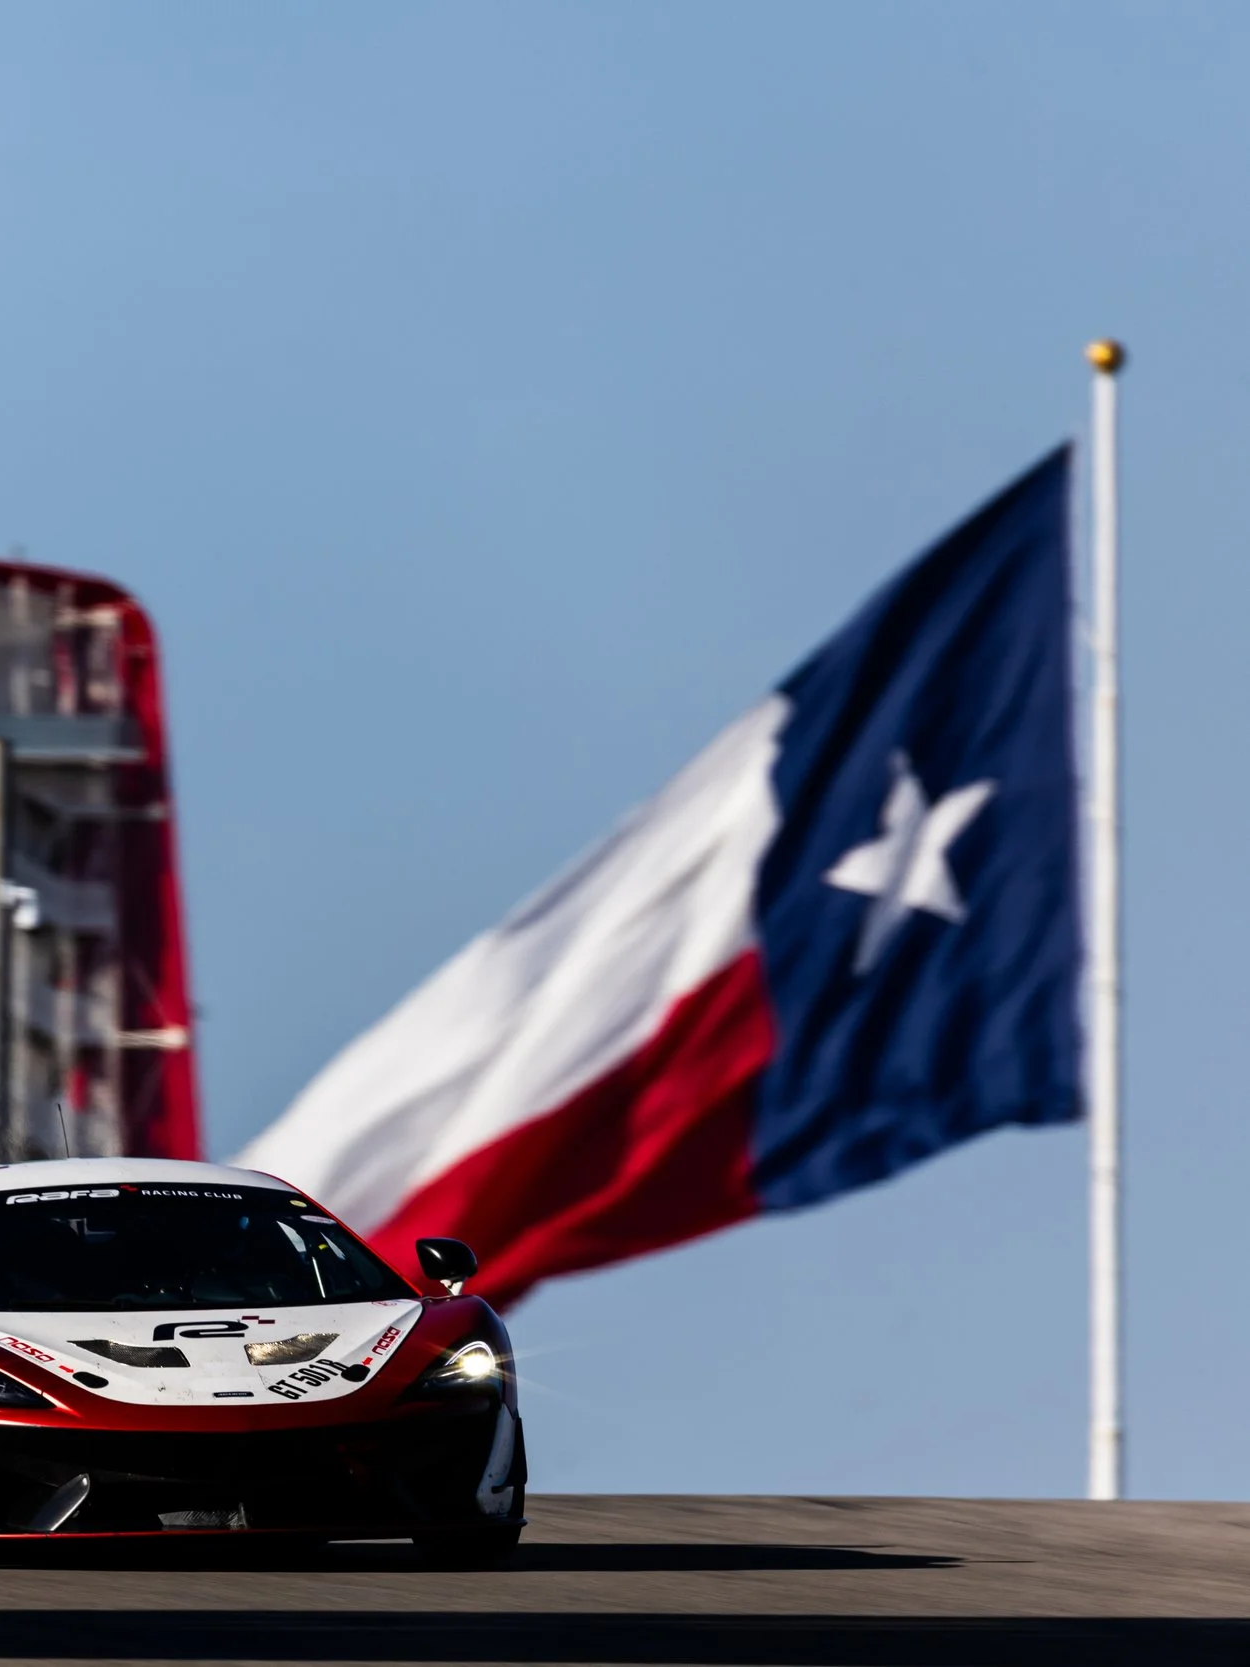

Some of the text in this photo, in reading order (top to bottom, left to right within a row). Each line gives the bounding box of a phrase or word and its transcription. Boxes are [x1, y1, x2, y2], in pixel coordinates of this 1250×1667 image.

[141, 1189, 199, 1197] RACING
[204, 1191, 243, 1200] CLUB
[268, 1358, 352, 1400] GT 501R
